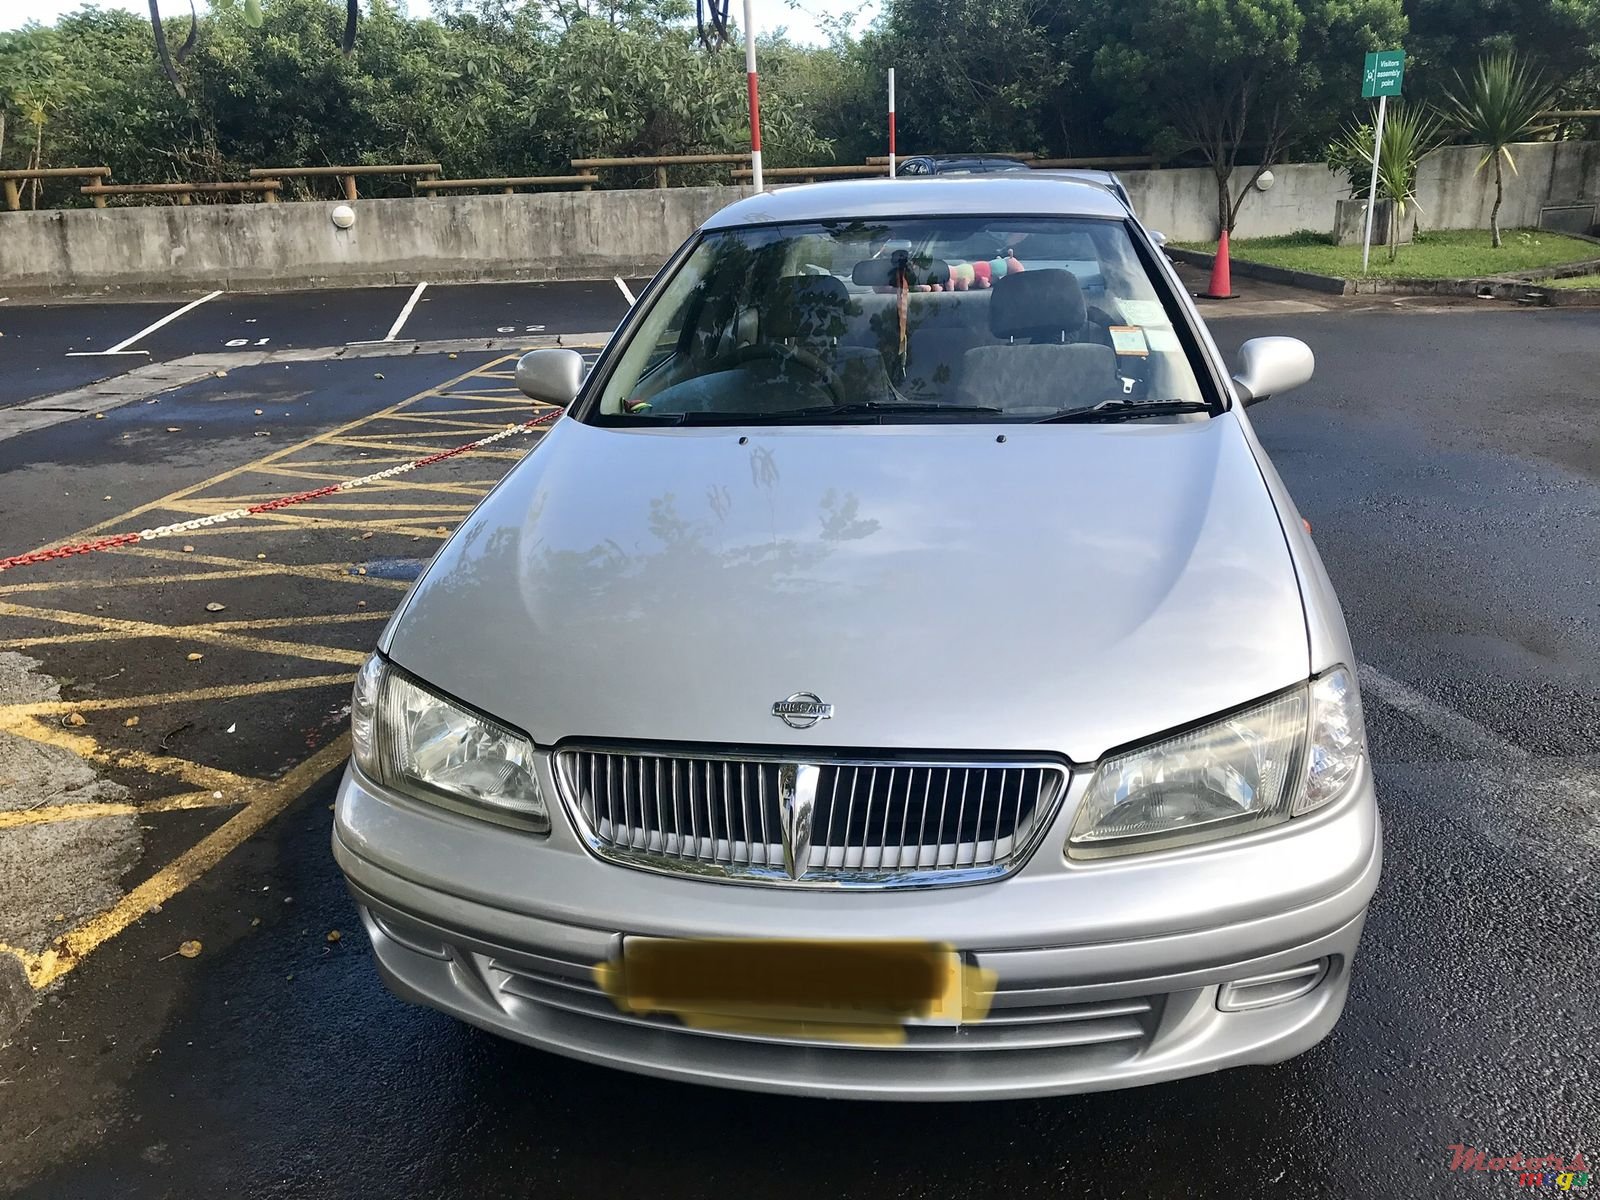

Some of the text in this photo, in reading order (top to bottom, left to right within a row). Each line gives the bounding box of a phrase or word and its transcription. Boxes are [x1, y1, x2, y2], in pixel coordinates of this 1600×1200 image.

[1377, 69, 1400, 78] assembly
[1380, 79, 1394, 89] point
[496, 325, 546, 333] 62
[224, 337, 270, 347] 61
[779, 702, 827, 714] NISSAN
